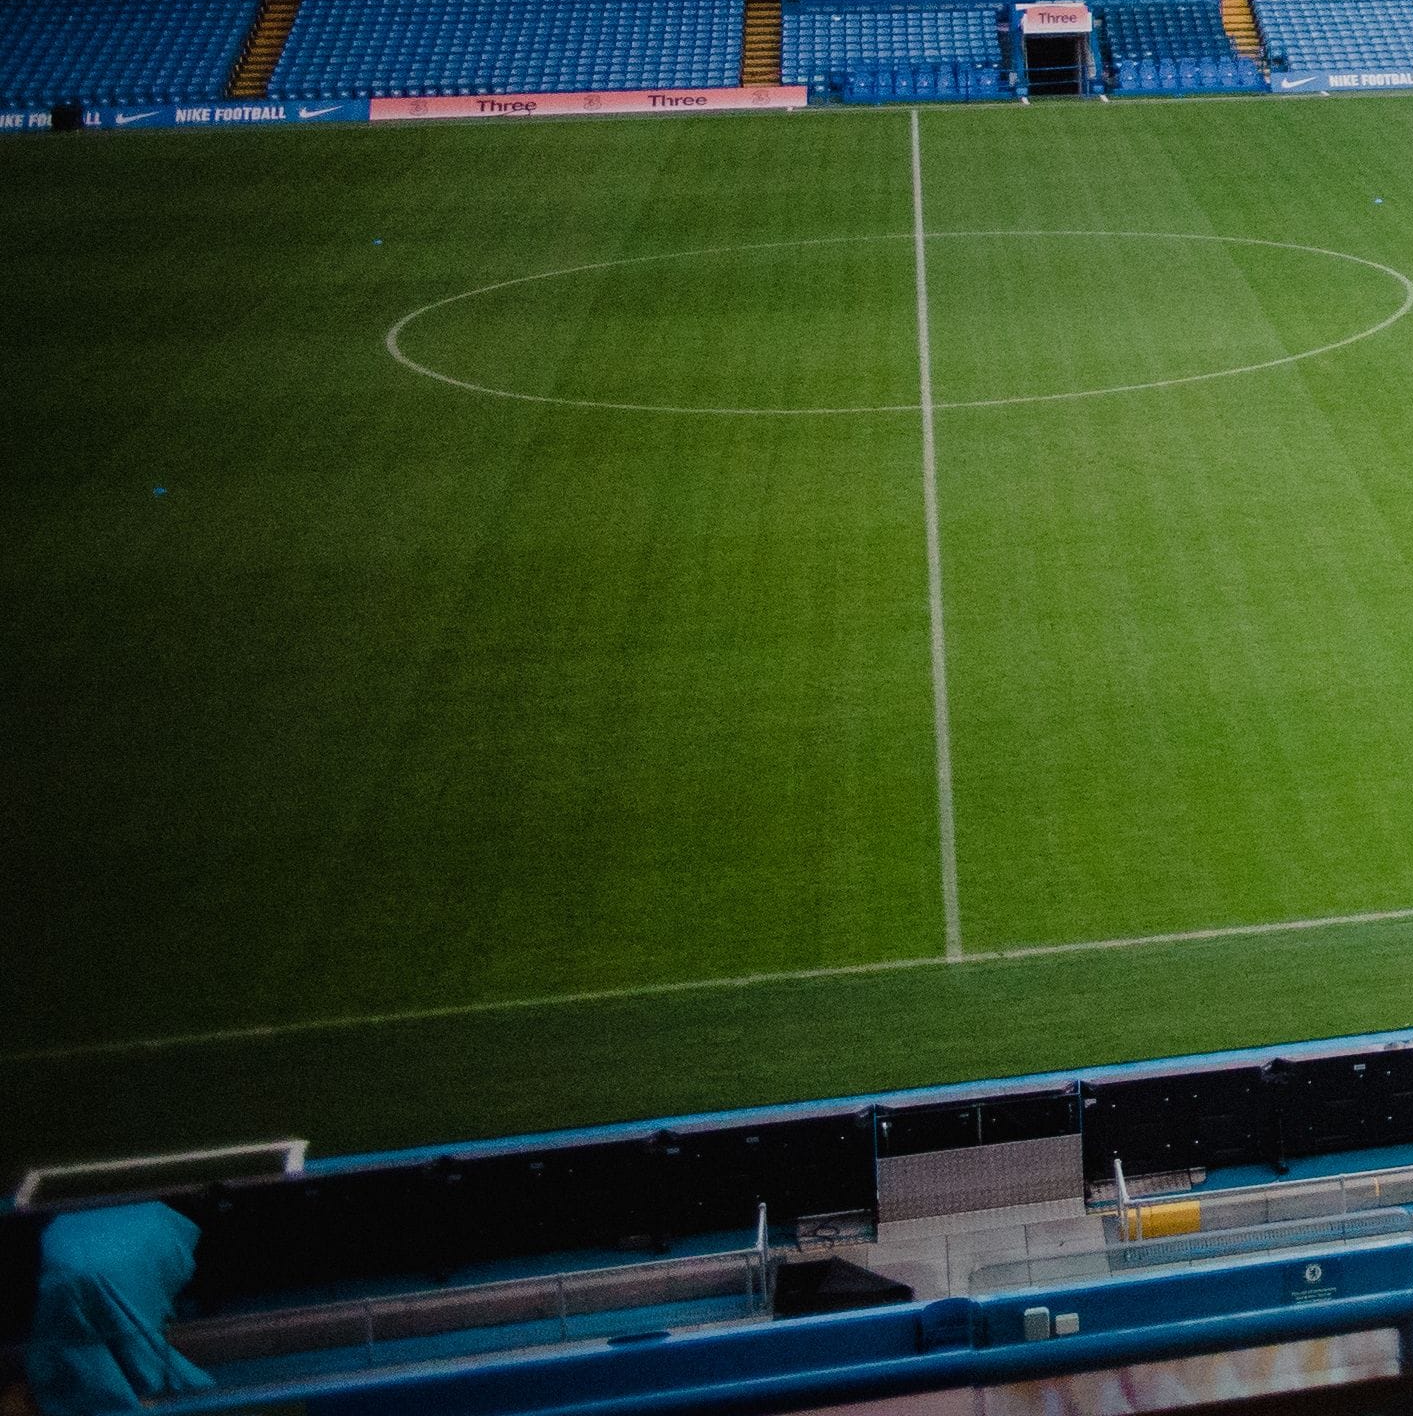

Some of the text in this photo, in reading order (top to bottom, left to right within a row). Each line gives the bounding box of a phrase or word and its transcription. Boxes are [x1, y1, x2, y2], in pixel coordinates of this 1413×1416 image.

[1038, 12, 1077, 25] Three
[1329, 74, 1359, 87] NIKE
[476, 99, 537, 113] Three
[648, 94, 708, 107] Three
[0, 114, 23, 127] IKE
[175, 107, 286, 123] NIKE FOOTBALL
